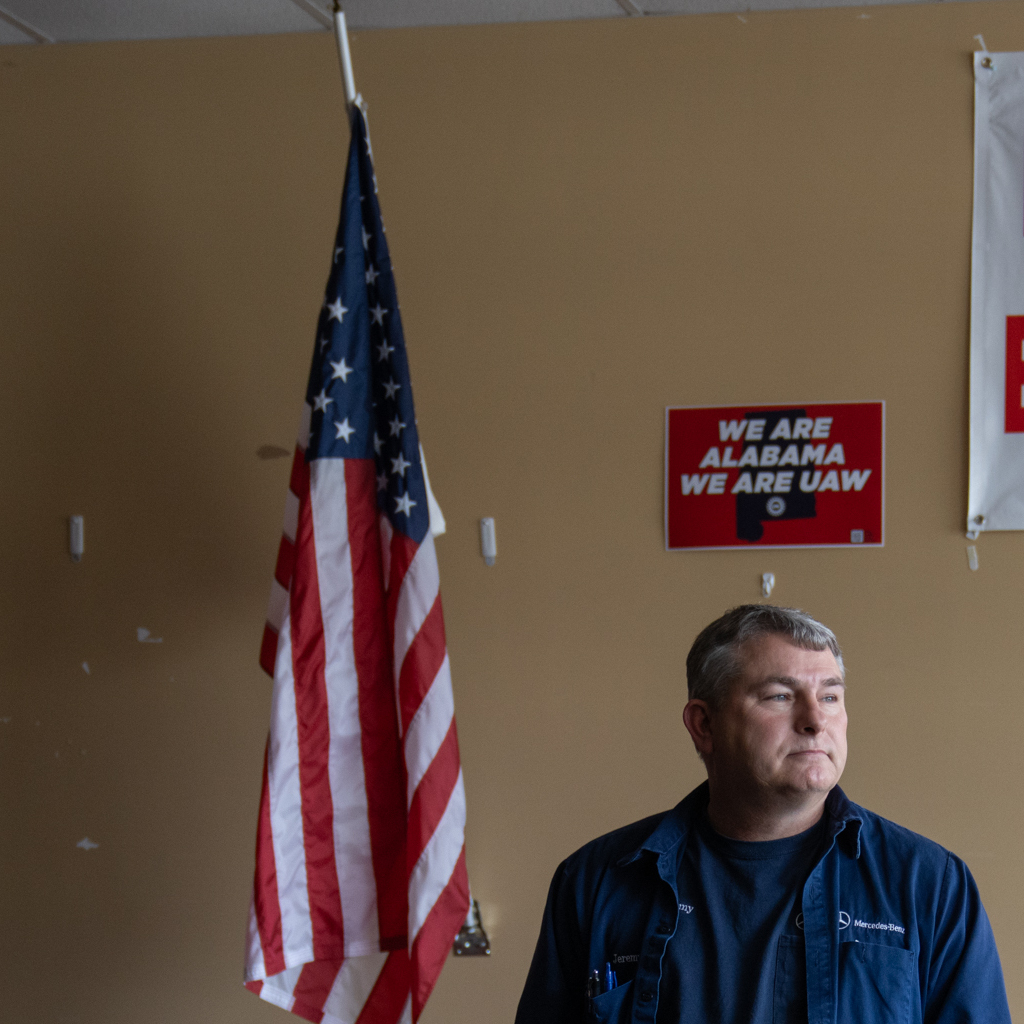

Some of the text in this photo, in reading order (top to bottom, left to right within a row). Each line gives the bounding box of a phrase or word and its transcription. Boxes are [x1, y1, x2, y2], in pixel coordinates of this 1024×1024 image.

[718, 416, 833, 442] WE ARE
[698, 443, 846, 468] ALABAMA
[680, 469, 872, 496] WE ARE UAW
[853, 919, 906, 935] Mercedes-Benz
[612, 953, 640, 965] Jerem
